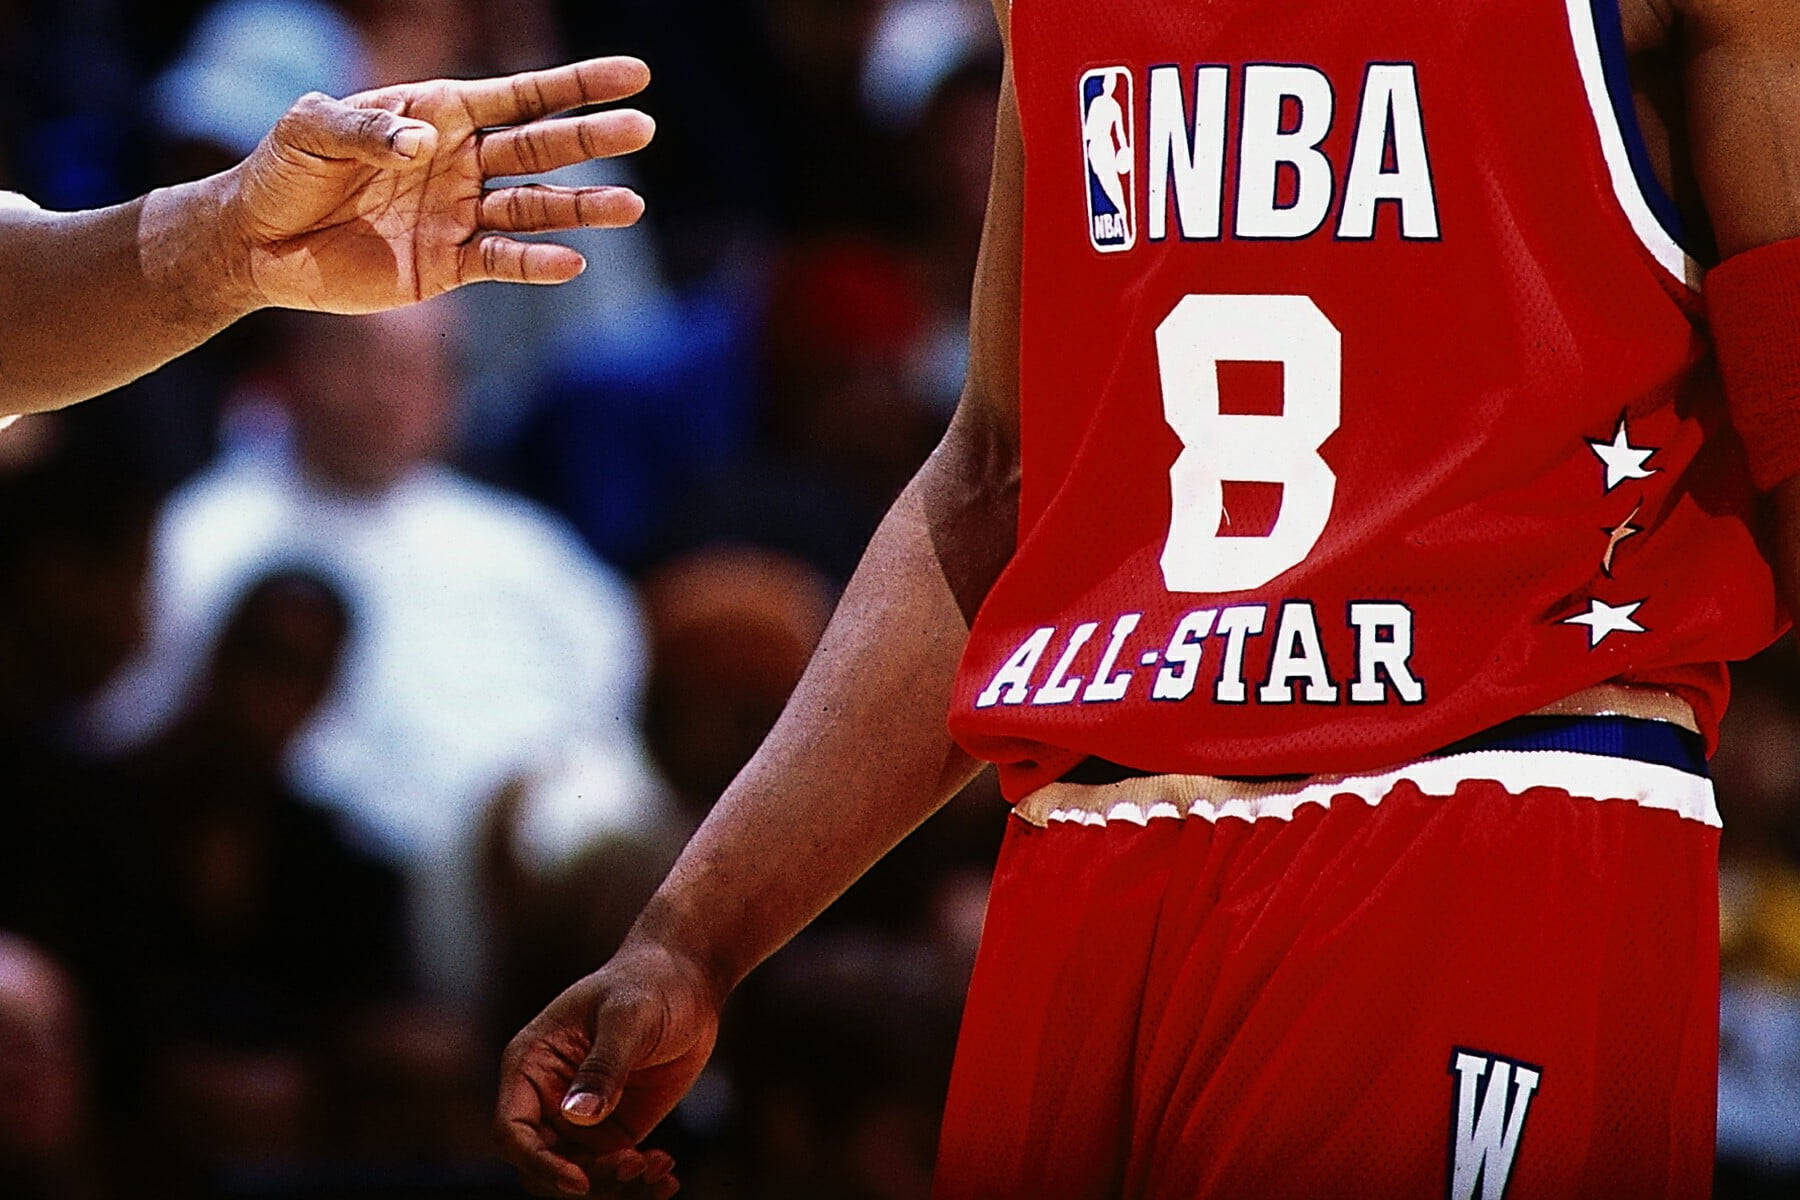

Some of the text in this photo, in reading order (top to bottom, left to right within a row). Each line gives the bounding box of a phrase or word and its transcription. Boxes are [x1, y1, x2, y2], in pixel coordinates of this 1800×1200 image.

[1094, 213, 1124, 240] NBA
[1145, 61, 1440, 244] NBA
[1154, 293, 1342, 593] 8
[974, 601, 1426, 709] ALL-STAR
[1447, 1045, 1544, 1200] W
